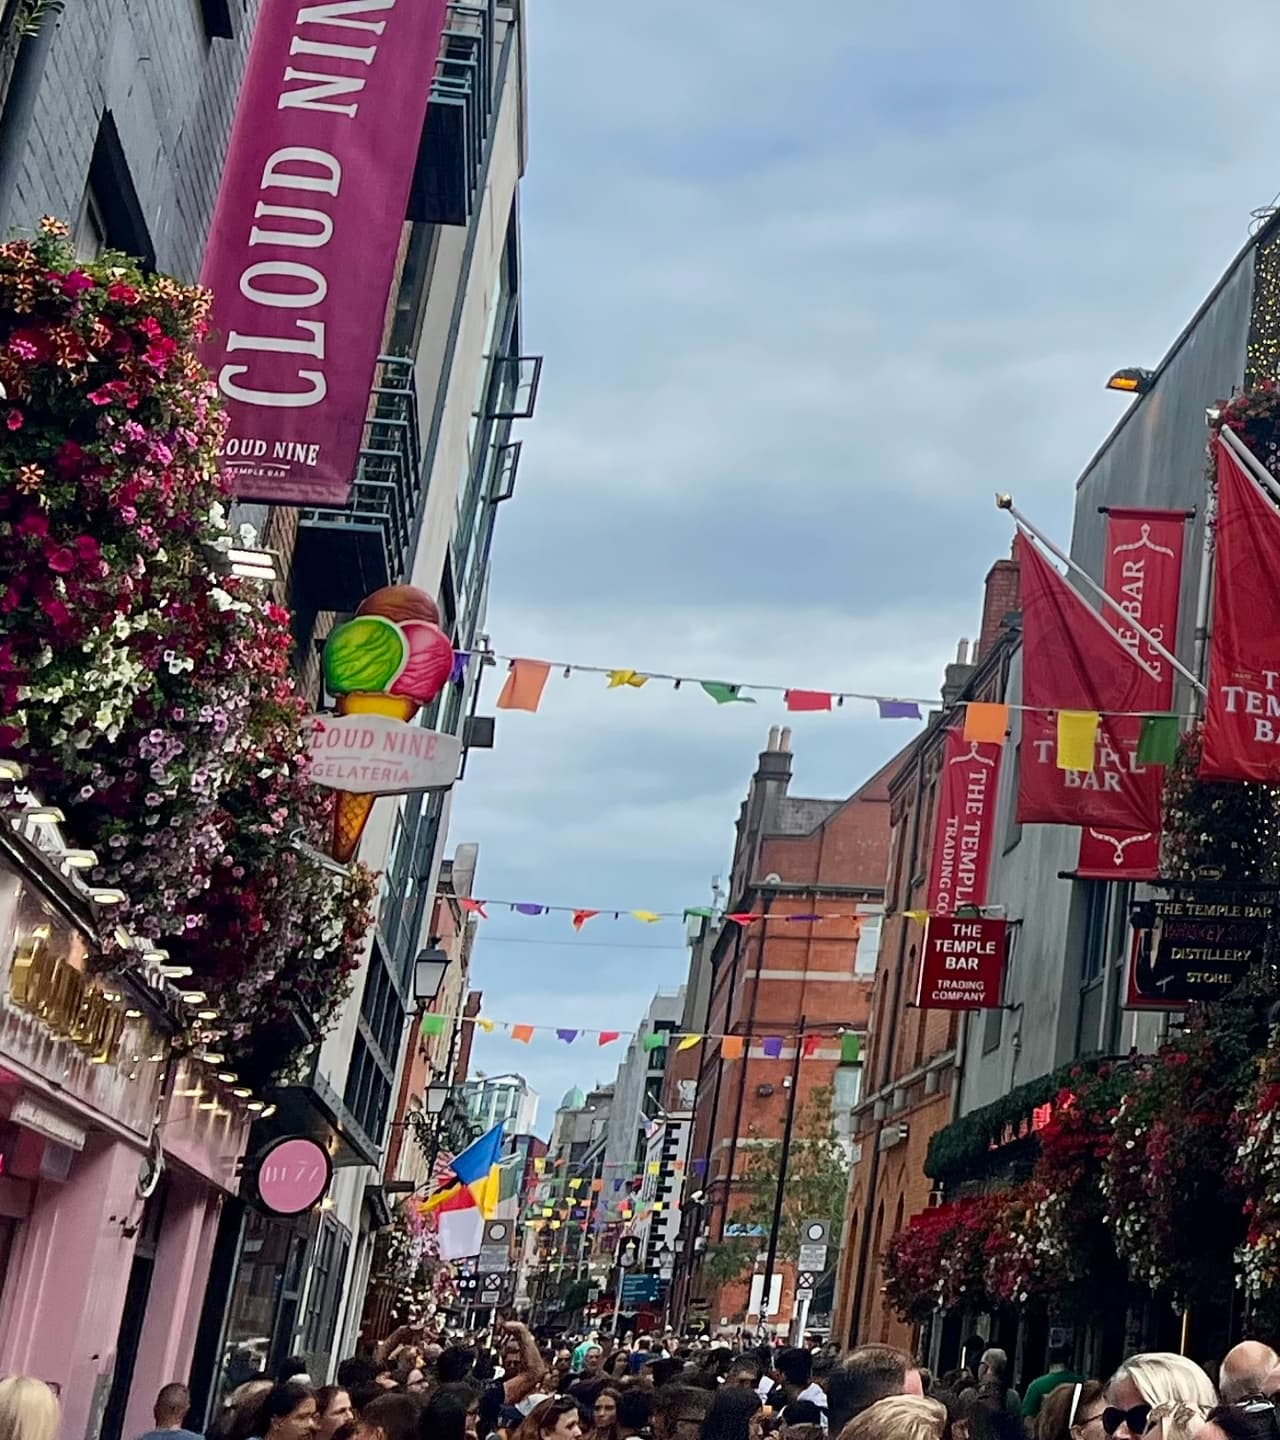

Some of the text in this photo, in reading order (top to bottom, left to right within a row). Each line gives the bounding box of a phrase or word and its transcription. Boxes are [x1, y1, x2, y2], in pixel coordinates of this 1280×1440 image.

[217, 146, 343, 409] CLOUD
[213, 438, 321, 467] LOUD NINE
[1119, 560, 1146, 619] BAR
[311, 727, 439, 762] LOUD NINE
[312, 763, 411, 784] GELATERIA
[1063, 770, 1122, 793] BAR
[965, 768, 988, 815] THE
[936, 815, 959, 890] TRADING
[1154, 901, 1273, 919] THE TEMPLE BAR
[951, 923, 982, 938] THE
[934, 939, 997, 956] TEMPLE
[1170, 947, 1252, 961] DISTILLERY
[945, 956, 979, 971] BAR
[937, 979, 985, 991] TRADING
[1185, 970, 1233, 985] STORE
[931, 990, 987, 1002] COMPANY
